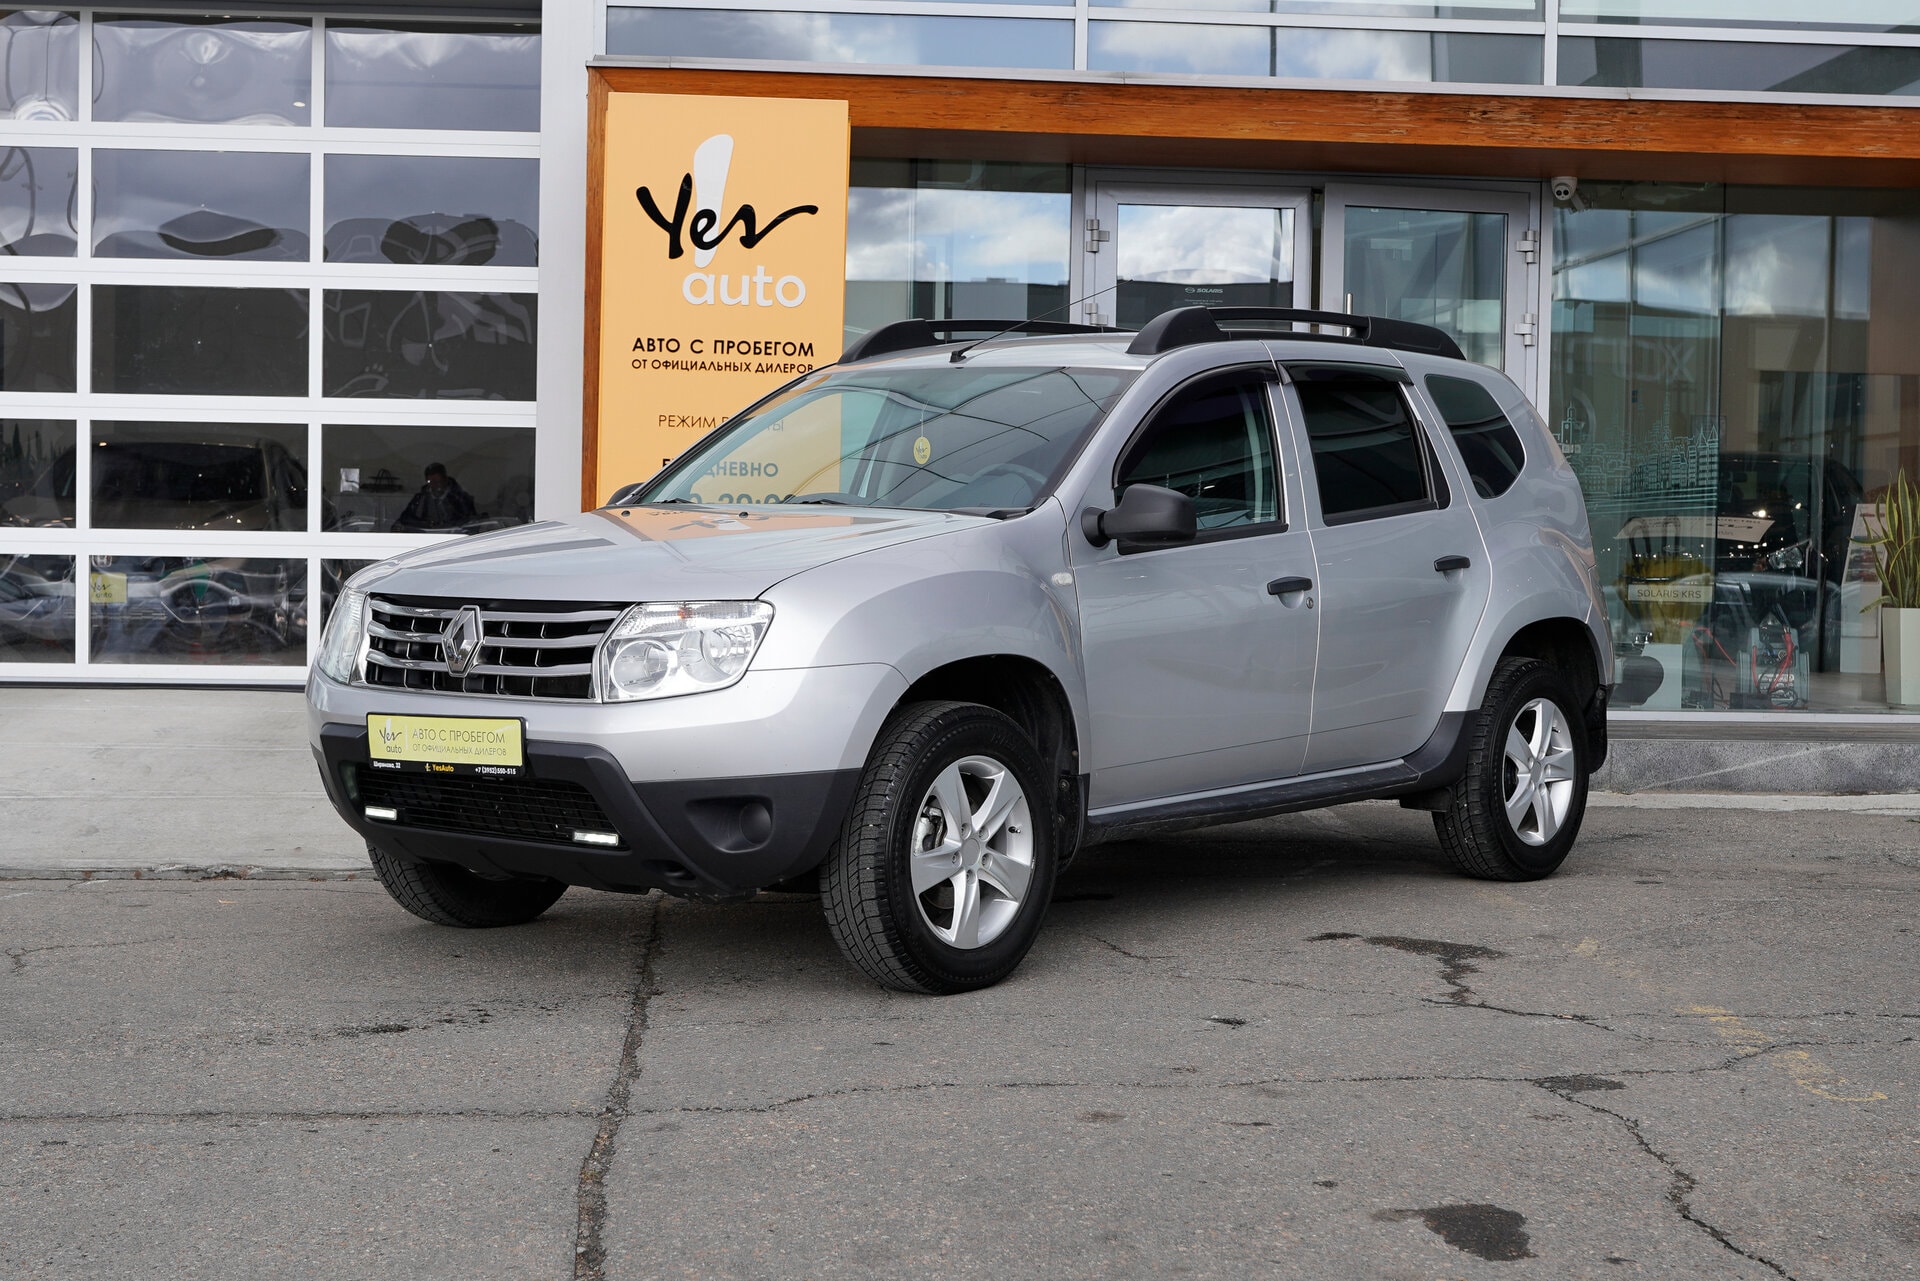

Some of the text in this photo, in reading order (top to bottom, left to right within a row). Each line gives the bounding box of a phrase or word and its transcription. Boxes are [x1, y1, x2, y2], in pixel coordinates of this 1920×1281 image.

[636, 172, 819, 260] Yes
[682, 265, 807, 308] auto
[632, 337, 814, 357] АВТО С ПРОБЕГОМ
[631, 359, 814, 374] ОТ ОФИЦИАЛЬНЫХ ДИЛЕРОВ
[658, 414, 717, 428] РЕЖИМ
[1637, 589, 1702, 599] SOLARIS KRS
[379, 727, 402, 744] Yes
[413, 728, 505, 743] АВТО С ПРОБЕГОМ
[386, 745, 402, 753] auto
[422, 744, 473, 754] ОФИЦИАЛЬНЫХ
[474, 747, 507, 756] ДИЛЕРОВ
[432, 764, 454, 772] YesAuto
